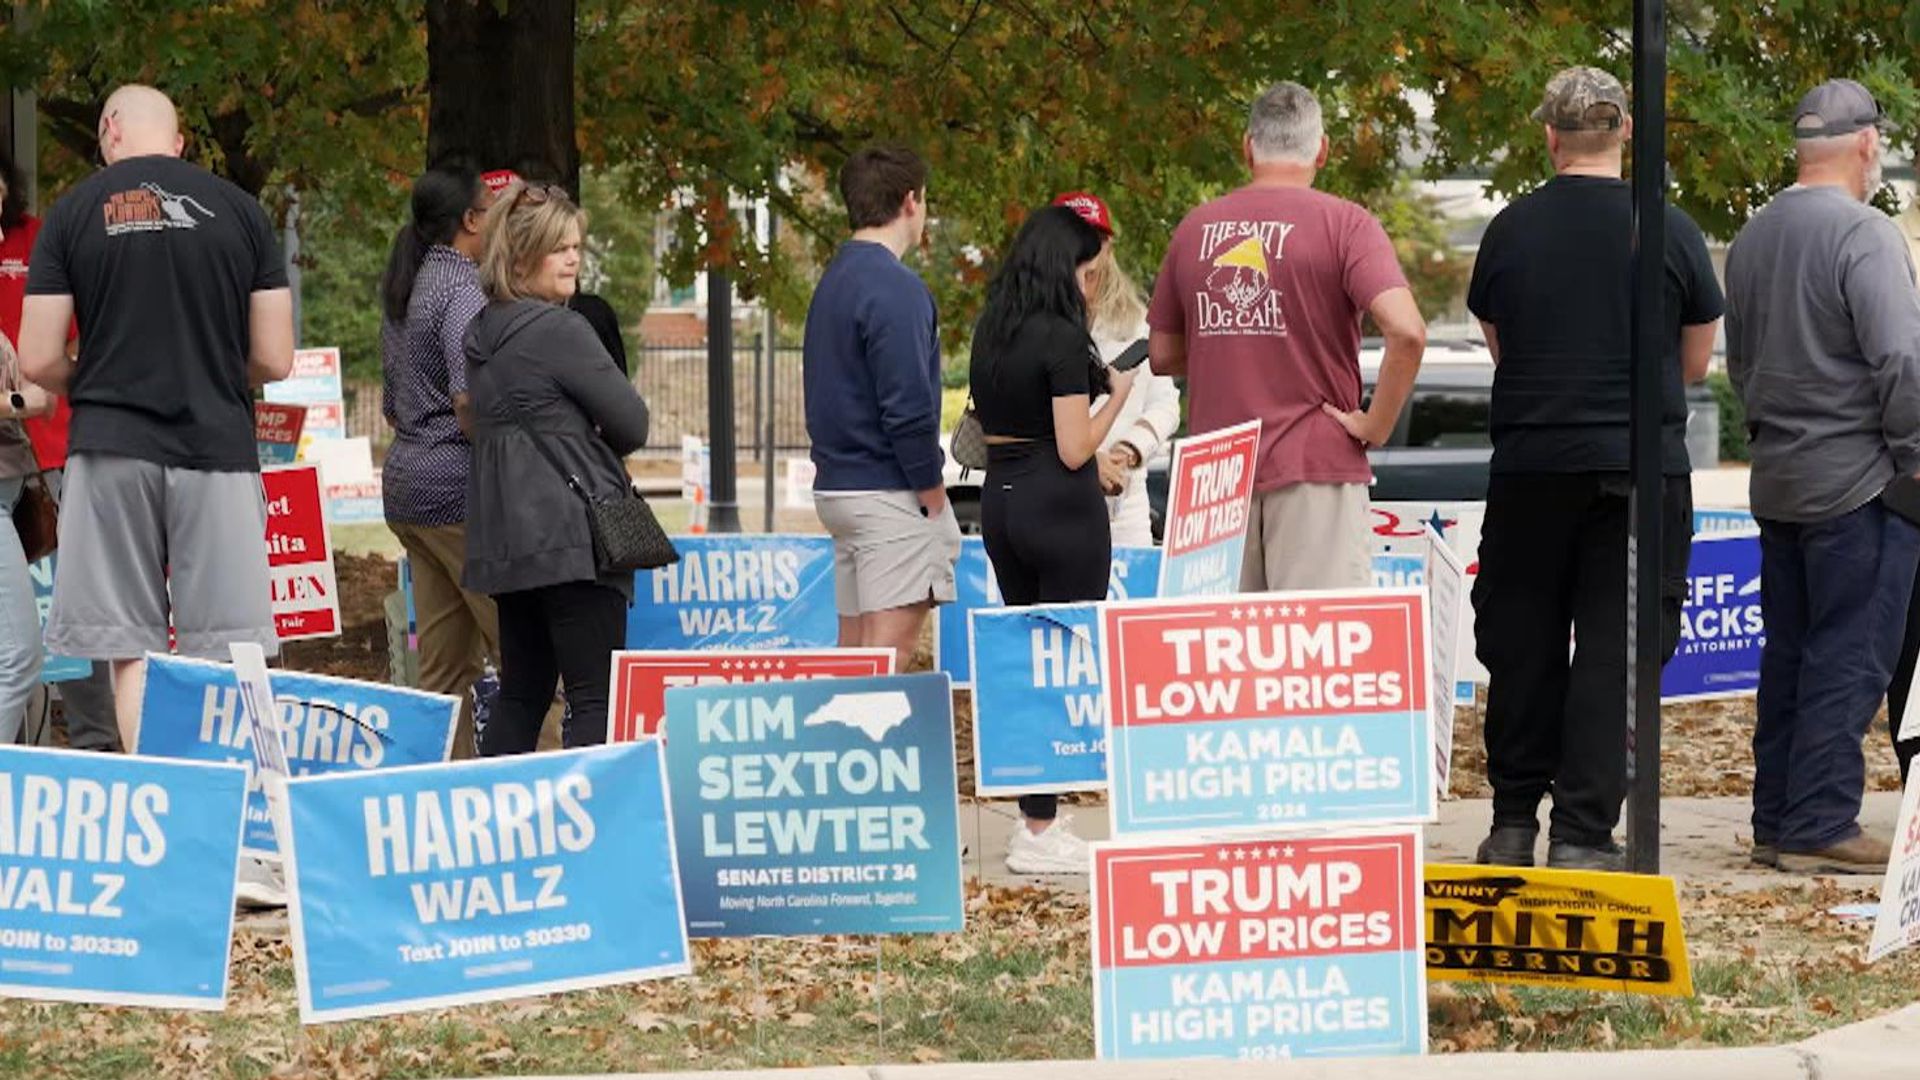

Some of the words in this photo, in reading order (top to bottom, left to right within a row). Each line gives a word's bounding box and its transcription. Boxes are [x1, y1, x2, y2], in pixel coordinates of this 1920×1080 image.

[1199, 220, 1236, 260] THE
[1237, 220, 1294, 260] SALTY
[256, 429, 293, 442] RICES
[1190, 453, 1245, 508] TRUMP
[1174, 509, 1208, 550] LOW
[1209, 499, 1244, 540] TAXES
[271, 575, 326, 602] LEN
[652, 549, 800, 605] HARRIS
[1683, 574, 1734, 607] FF
[679, 605, 777, 636] WALZ
[1680, 605, 1764, 641] ACKS
[1163, 621, 1373, 675] TRUMP
[1685, 639, 1751, 654] ATTORNEY
[1135, 679, 1242, 719] LOW
[1255, 672, 1402, 711] PRICES
[697, 696, 795, 743] KIM
[1052, 740, 1087, 756] Text
[1186, 726, 1364, 763] KAMALA
[699, 747, 921, 800] SEXTON
[1145, 768, 1253, 801] HIGH
[1265, 758, 1401, 795] PRICES
[363, 774, 596, 877] HARRIS
[702, 805, 931, 857] LEWTER
[1257, 804, 1307, 820] 2024
[411, 864, 567, 924] WALZ
[717, 868, 793, 887] SENATE
[799, 865, 887, 883] DISTRICT
[892, 864, 917, 881] 34
[1151, 861, 1362, 917] TRUMP
[1429, 882, 1498, 898] VINNY
[757, 893, 785, 908] North
[0, 929, 41, 949] OIN
[45, 935, 66, 951] to
[69, 936, 139, 956] 30330
[399, 942, 444, 963] Text
[448, 936, 496, 958] JOIN
[500, 935, 522, 951] to
[525, 923, 591, 947] 30330
[1123, 920, 1226, 960] LOW
[1239, 911, 1392, 953] PRICES
[1433, 908, 1665, 957] MITH
[1426, 947, 1652, 978] OVERNOR
[1170, 965, 1349, 1006] KAMALA
[1131, 1007, 1234, 1045] HIGH
[1246, 996, 1391, 1036] PRICES
